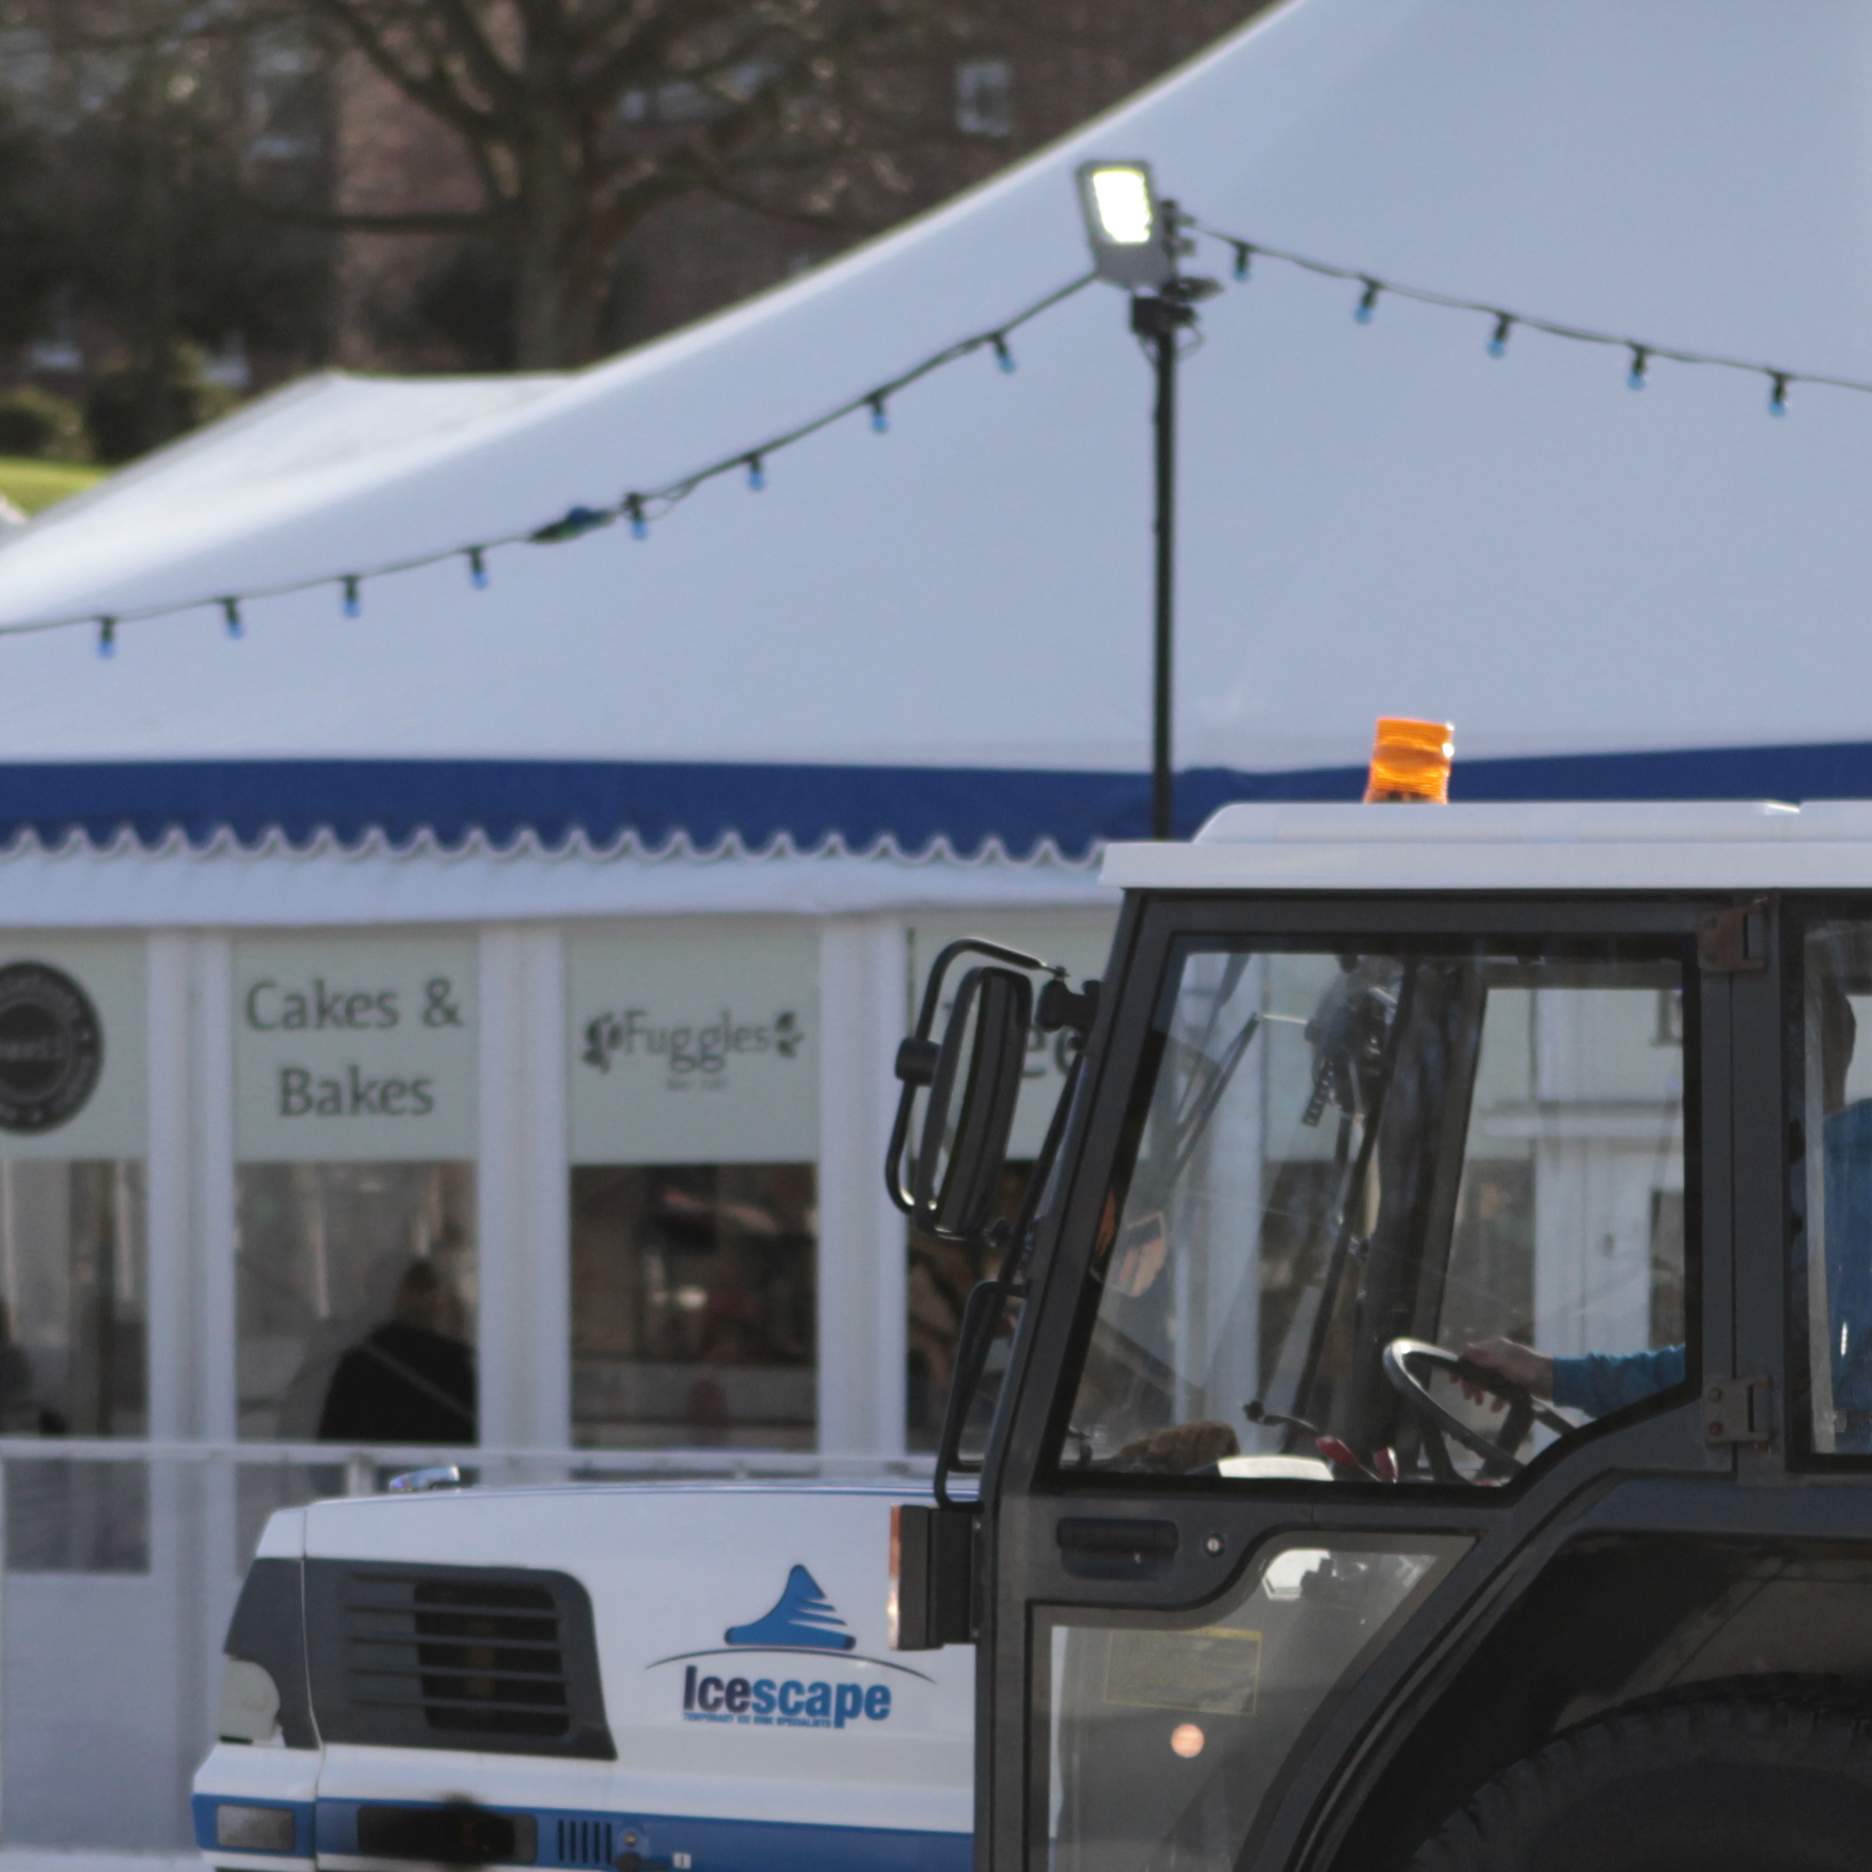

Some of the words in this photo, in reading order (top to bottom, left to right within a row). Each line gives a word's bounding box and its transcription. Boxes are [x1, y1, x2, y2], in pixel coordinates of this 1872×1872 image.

[245, 977, 401, 1031] Cakes
[422, 976, 464, 1028] &
[625, 1008, 769, 1074] Fuggles
[280, 1063, 436, 1117] Bakes
[683, 1665, 892, 1729] Icescape
